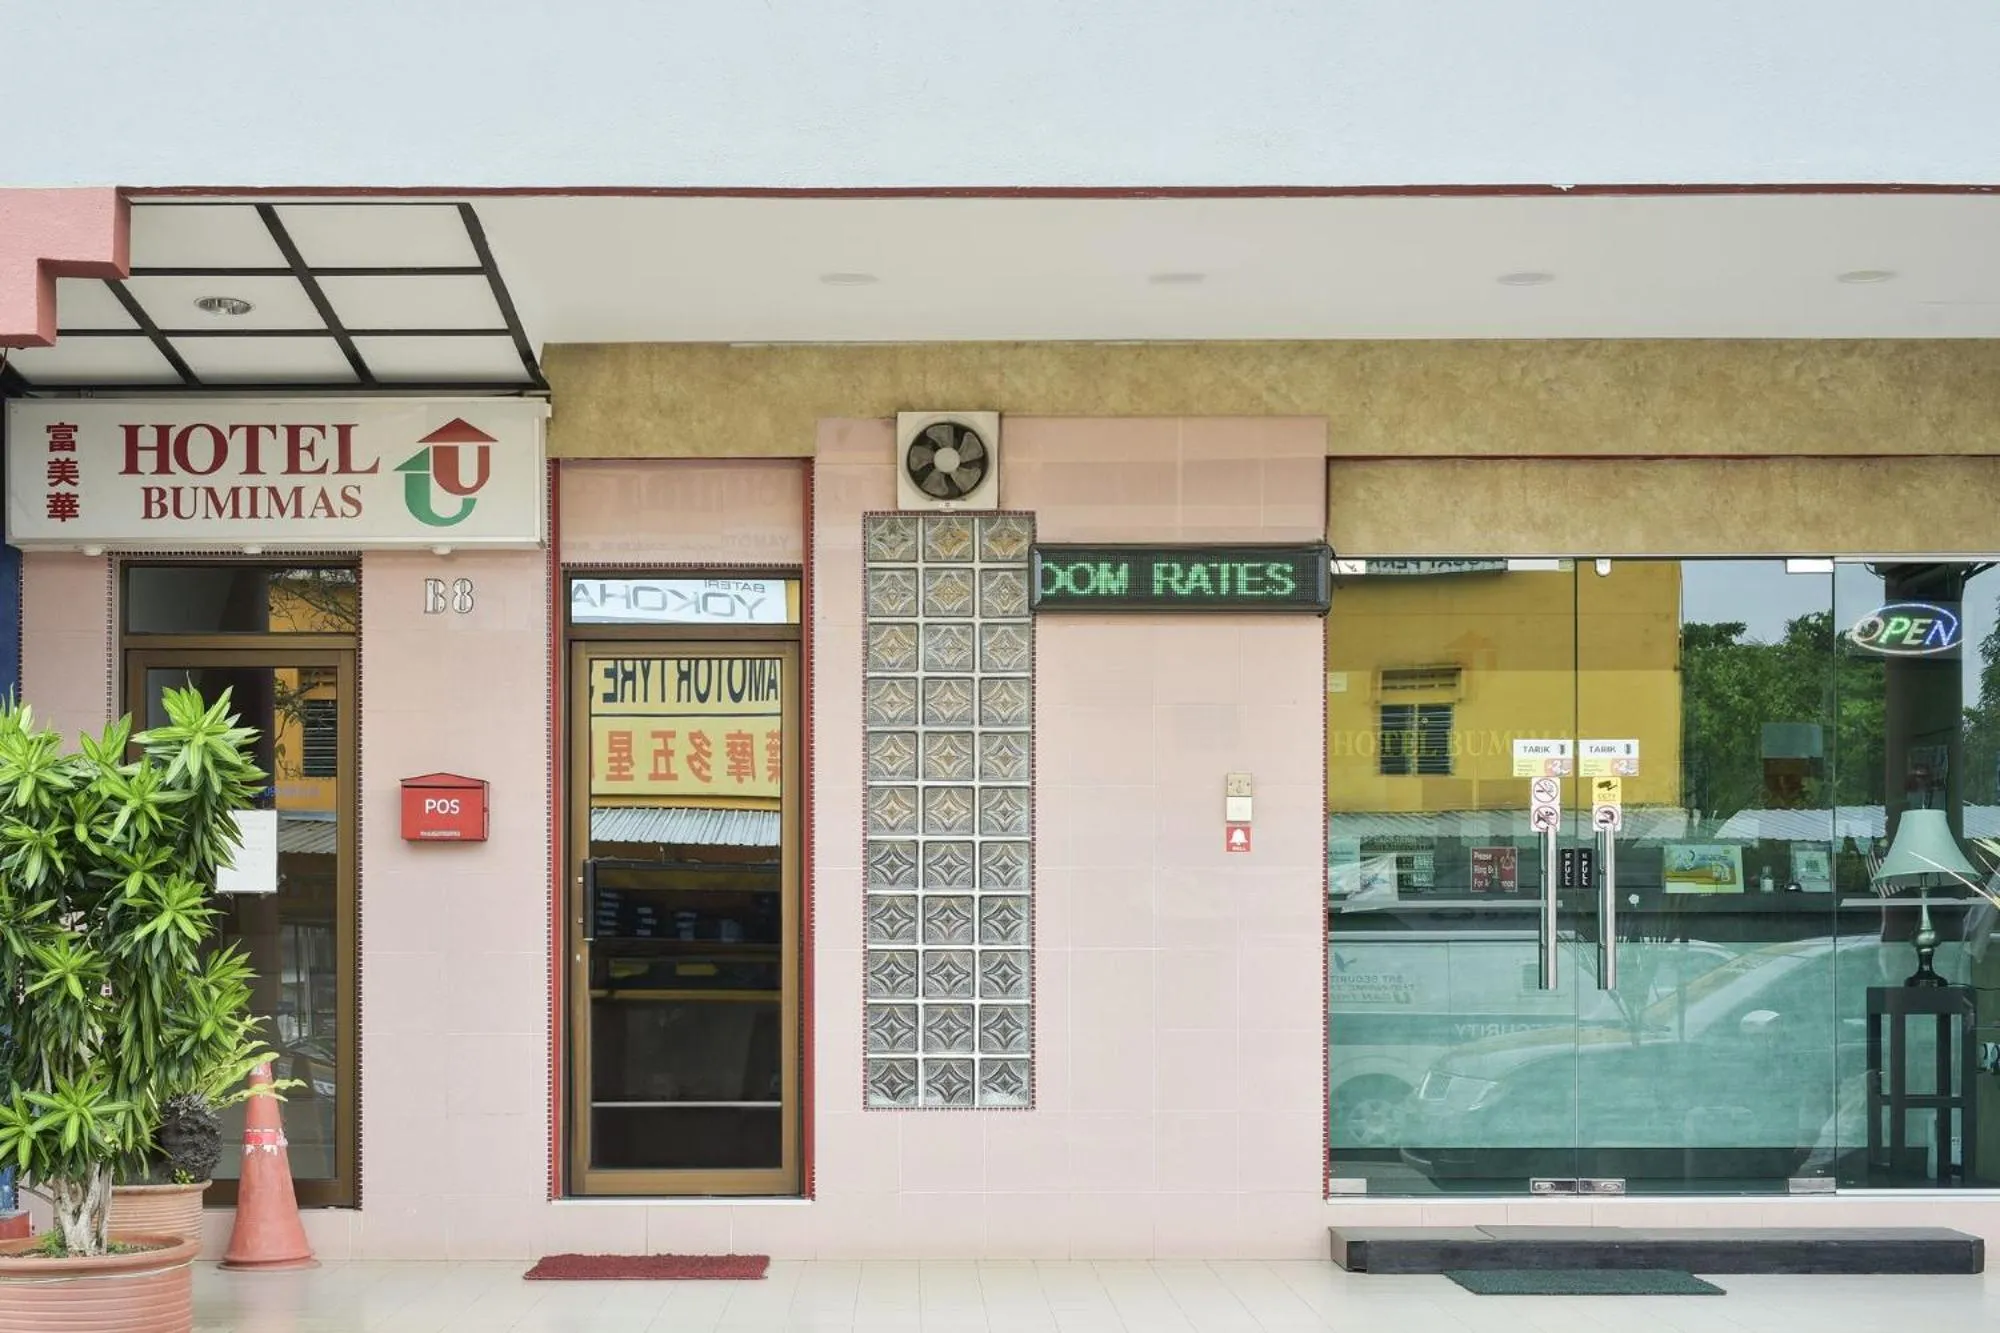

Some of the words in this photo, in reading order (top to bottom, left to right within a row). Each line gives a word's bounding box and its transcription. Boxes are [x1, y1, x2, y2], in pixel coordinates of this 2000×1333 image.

[119, 423, 380, 475] HOTEL
[46, 422, 80, 522] 富美華
[141, 484, 363, 520] BUMIMAS
[1151, 562, 1297, 596] RATES
[424, 577, 475, 614] B8
[1852, 616, 1958, 647] OPEN
[1523, 746, 1551, 754] TARIK
[1589, 746, 1617, 754] TARIK
[425, 798, 460, 815] POS
[1564, 860, 1572, 886] PULL
[1581, 860, 1589, 886] PULL
